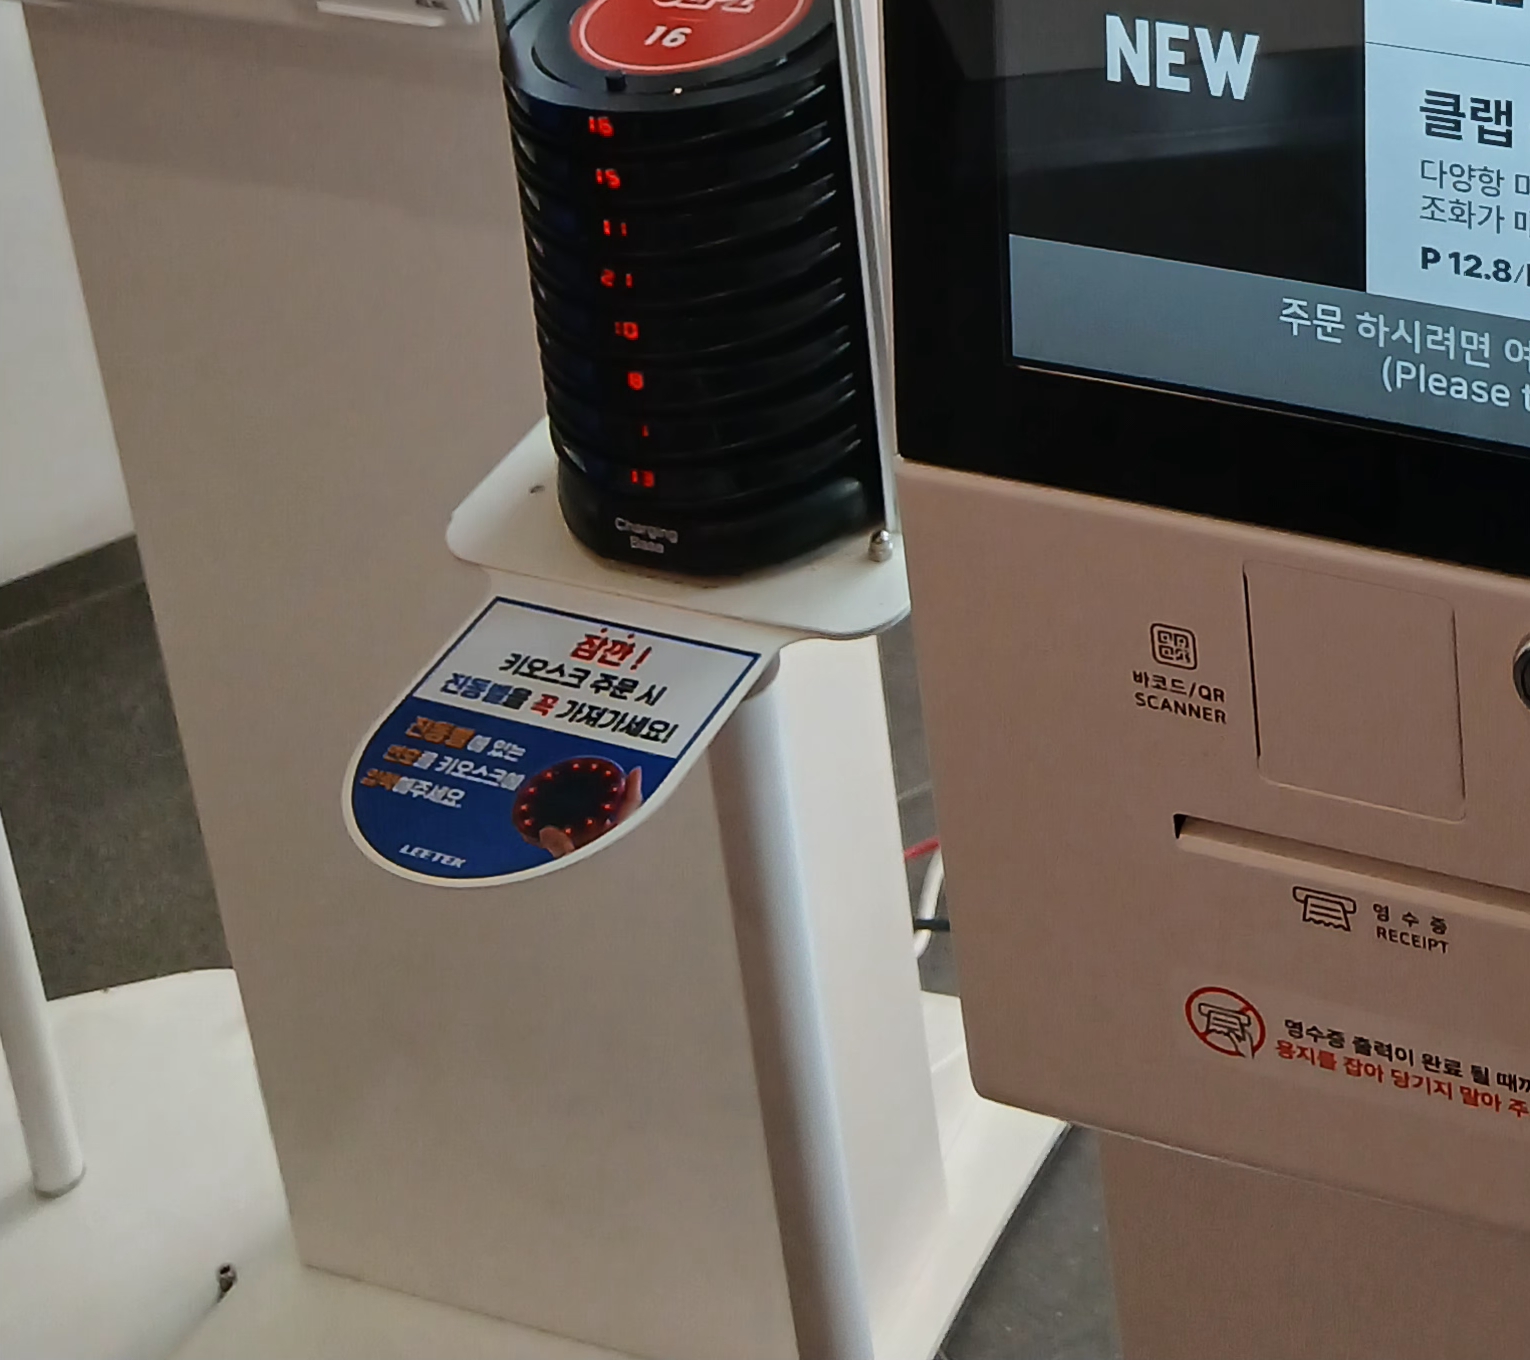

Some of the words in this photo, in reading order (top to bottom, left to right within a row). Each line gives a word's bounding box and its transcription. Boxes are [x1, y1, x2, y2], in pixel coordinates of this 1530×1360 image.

[643, 24, 693, 49] 16
[1104, 13, 1260, 101] NEW
[1419, 89, 1513, 149] 클랩
[1419, 194, 1506, 234] 조화가
[1420, 246, 1441, 271] P
[1278, 296, 1346, 344] 주문
[1356, 311, 1492, 370] 하시려면
[1381, 354, 1511, 408] (Please
[498, 652, 592, 690] 키오스크
[589, 672, 640, 701] 주문
[634, 685, 668, 707] 시
[1132, 669, 1225, 704] 바코드/QR
[440, 672, 534, 711] 진동벨을
[530, 693, 561, 717] 꼭
[554, 698, 680, 745] 가져가세요!
[1134, 691, 1227, 725] SCANNER
[1376, 925, 1449, 955] RECEIPT
[1284, 1018, 1346, 1050] 영수증
[1351, 1034, 1415, 1067] 출력이
[1421, 1052, 1464, 1078] 완료
[1274, 1038, 1338, 1072] 용지를
[1342, 1054, 1385, 1084] 잡아
[1390, 1067, 1453, 1101] 당기지
[1458, 1084, 1503, 1113] 말아
